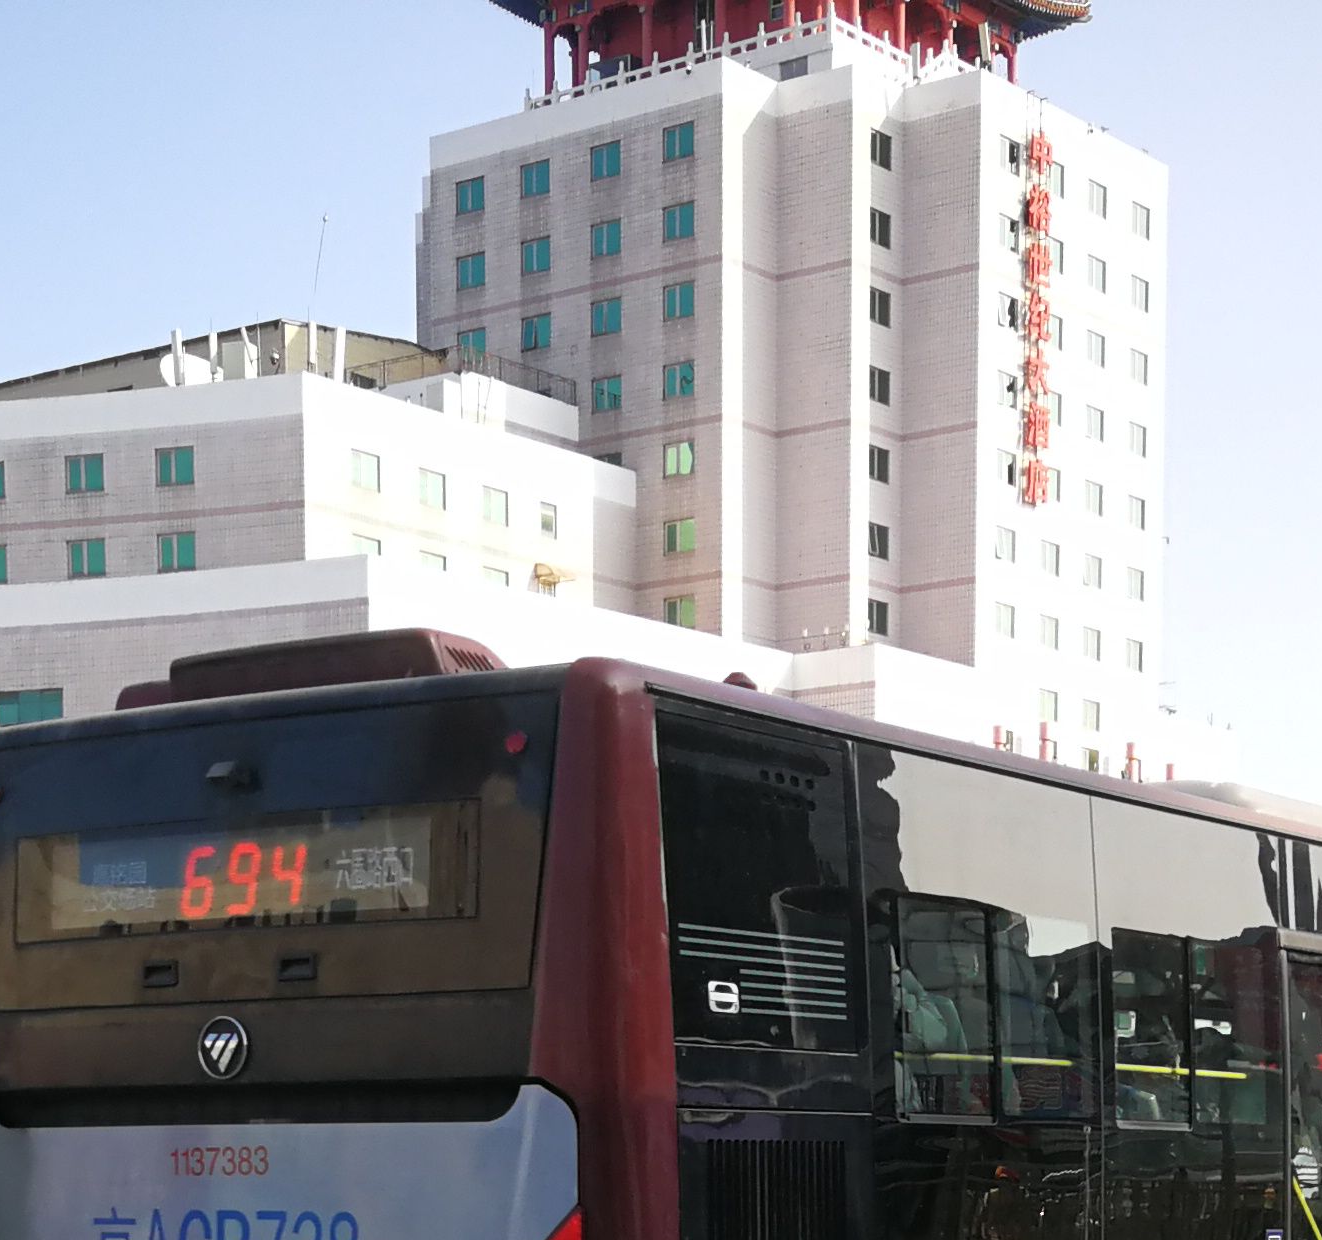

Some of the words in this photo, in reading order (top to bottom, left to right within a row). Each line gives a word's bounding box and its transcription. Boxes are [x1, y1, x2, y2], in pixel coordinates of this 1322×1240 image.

[1026, 131, 1053, 504] 中裕世纪大酒店
[181, 842, 307, 919] 694
[171, 1147, 269, 1176] 1137383
